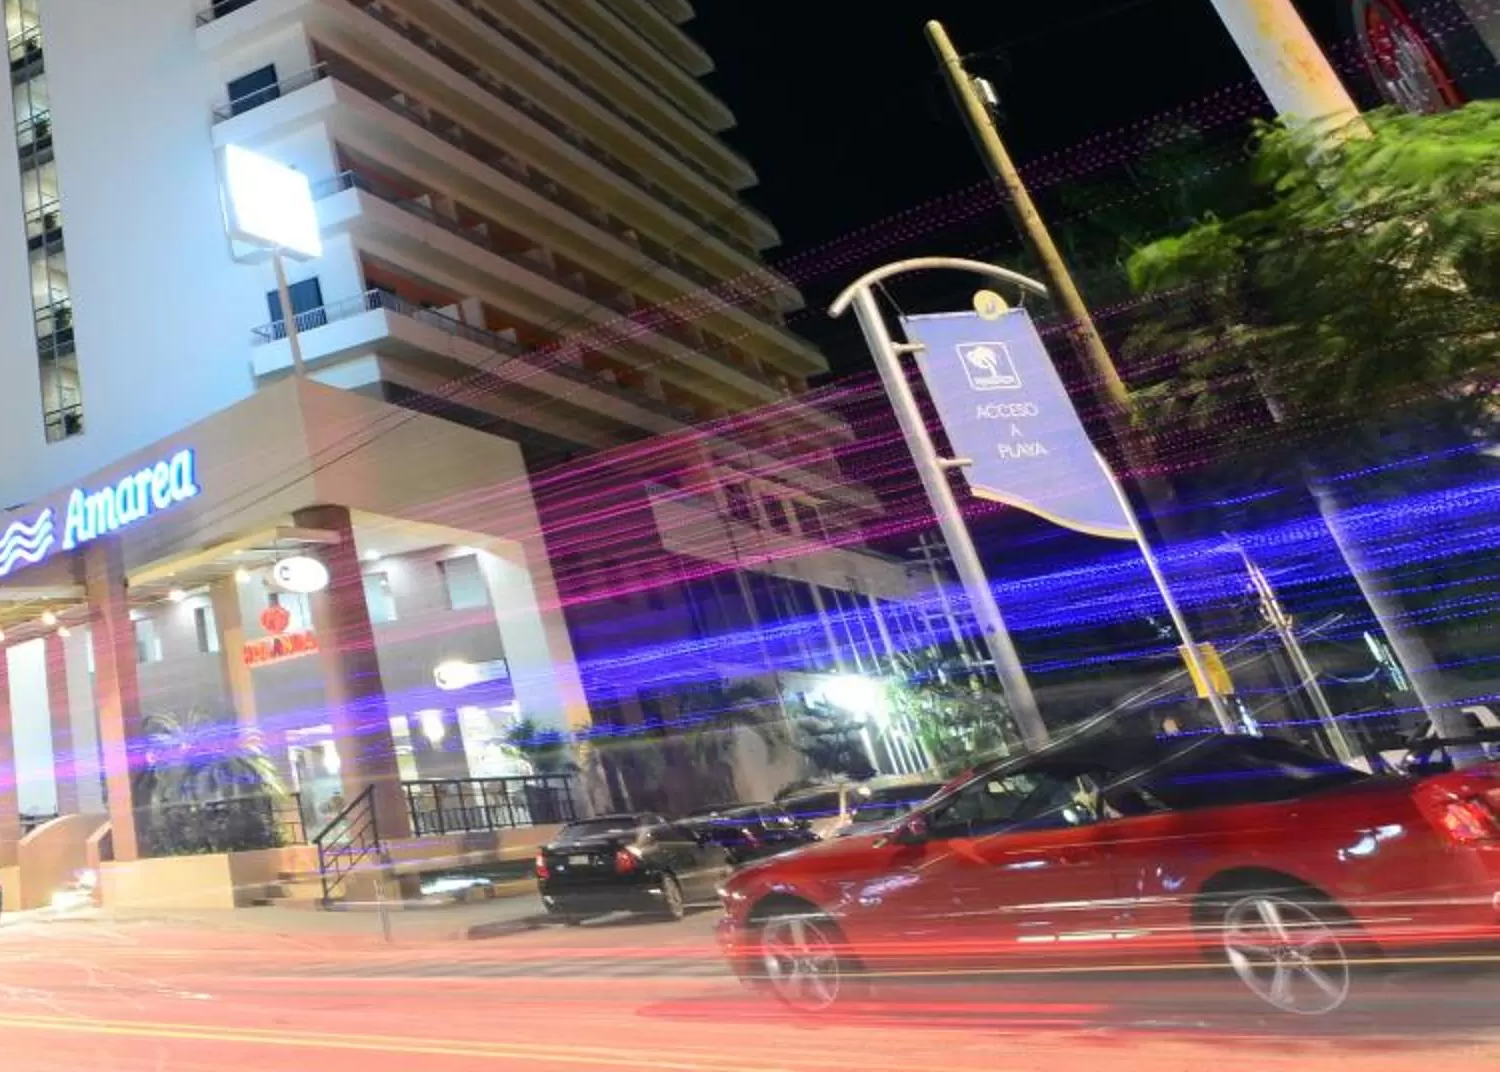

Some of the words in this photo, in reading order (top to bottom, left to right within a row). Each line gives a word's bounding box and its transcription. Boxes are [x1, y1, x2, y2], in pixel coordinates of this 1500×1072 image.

[975, 402, 1039, 419] ACCESO
[1011, 423, 1022, 437] A
[997, 441, 1049, 459] PLAYA
[62, 448, 198, 549] Amarea
